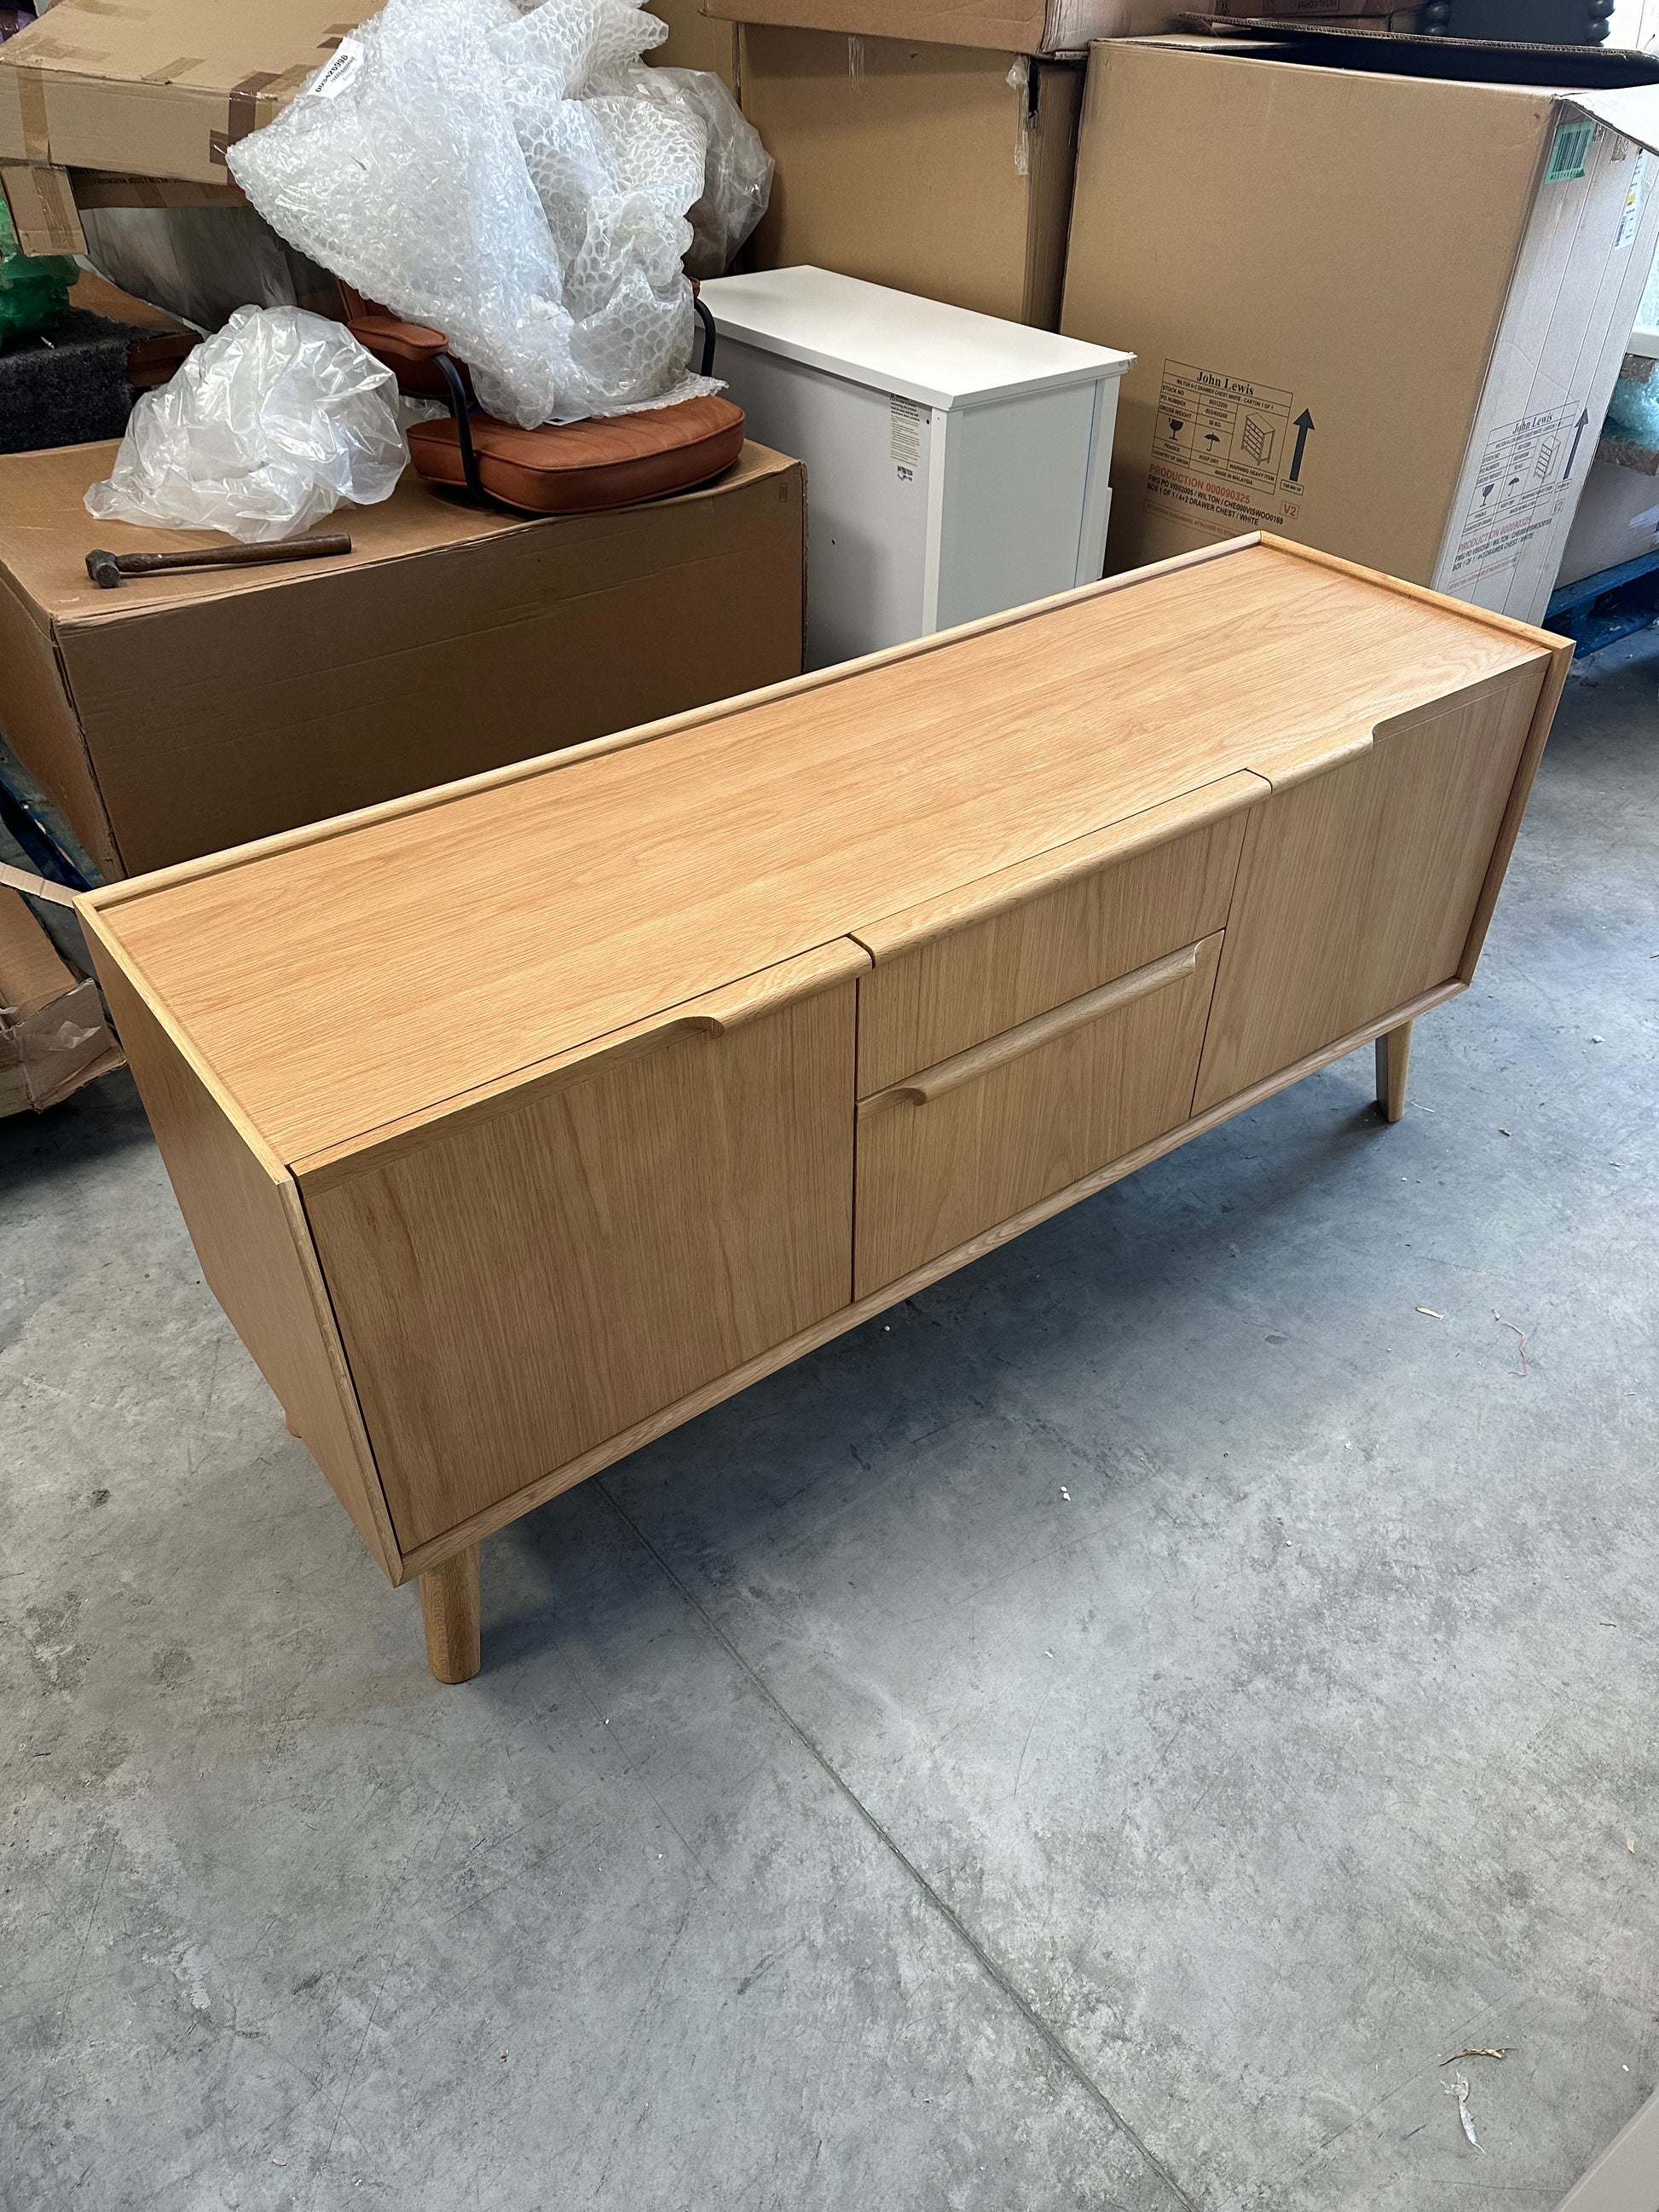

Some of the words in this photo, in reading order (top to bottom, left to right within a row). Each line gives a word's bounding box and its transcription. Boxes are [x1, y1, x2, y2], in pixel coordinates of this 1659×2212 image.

[1196, 371, 1221, 387] John
[1224, 378, 1254, 396] Lewis
[1243, 397, 1260, 407] CARTON
[1512, 418, 1531, 434] John
[1531, 409, 1554, 427] Lewis
[1149, 463, 1204, 489] PRODUCTION
[1205, 482, 1250, 505] 000090325
[1160, 478, 1169, 488] PO
[1197, 490, 1220, 504] WILTON
[1147, 482, 1159, 492] BOX
[1163, 488, 1171, 496] OF
[1188, 496, 1215, 511] DRAWER
[1215, 505, 1235, 518] CHEST
[1239, 512, 1259, 526] WHITE
[1282, 503, 1297, 517] V2
[1552, 500, 1564, 512] V2
[1457, 527, 1500, 553] PRODUCTION
